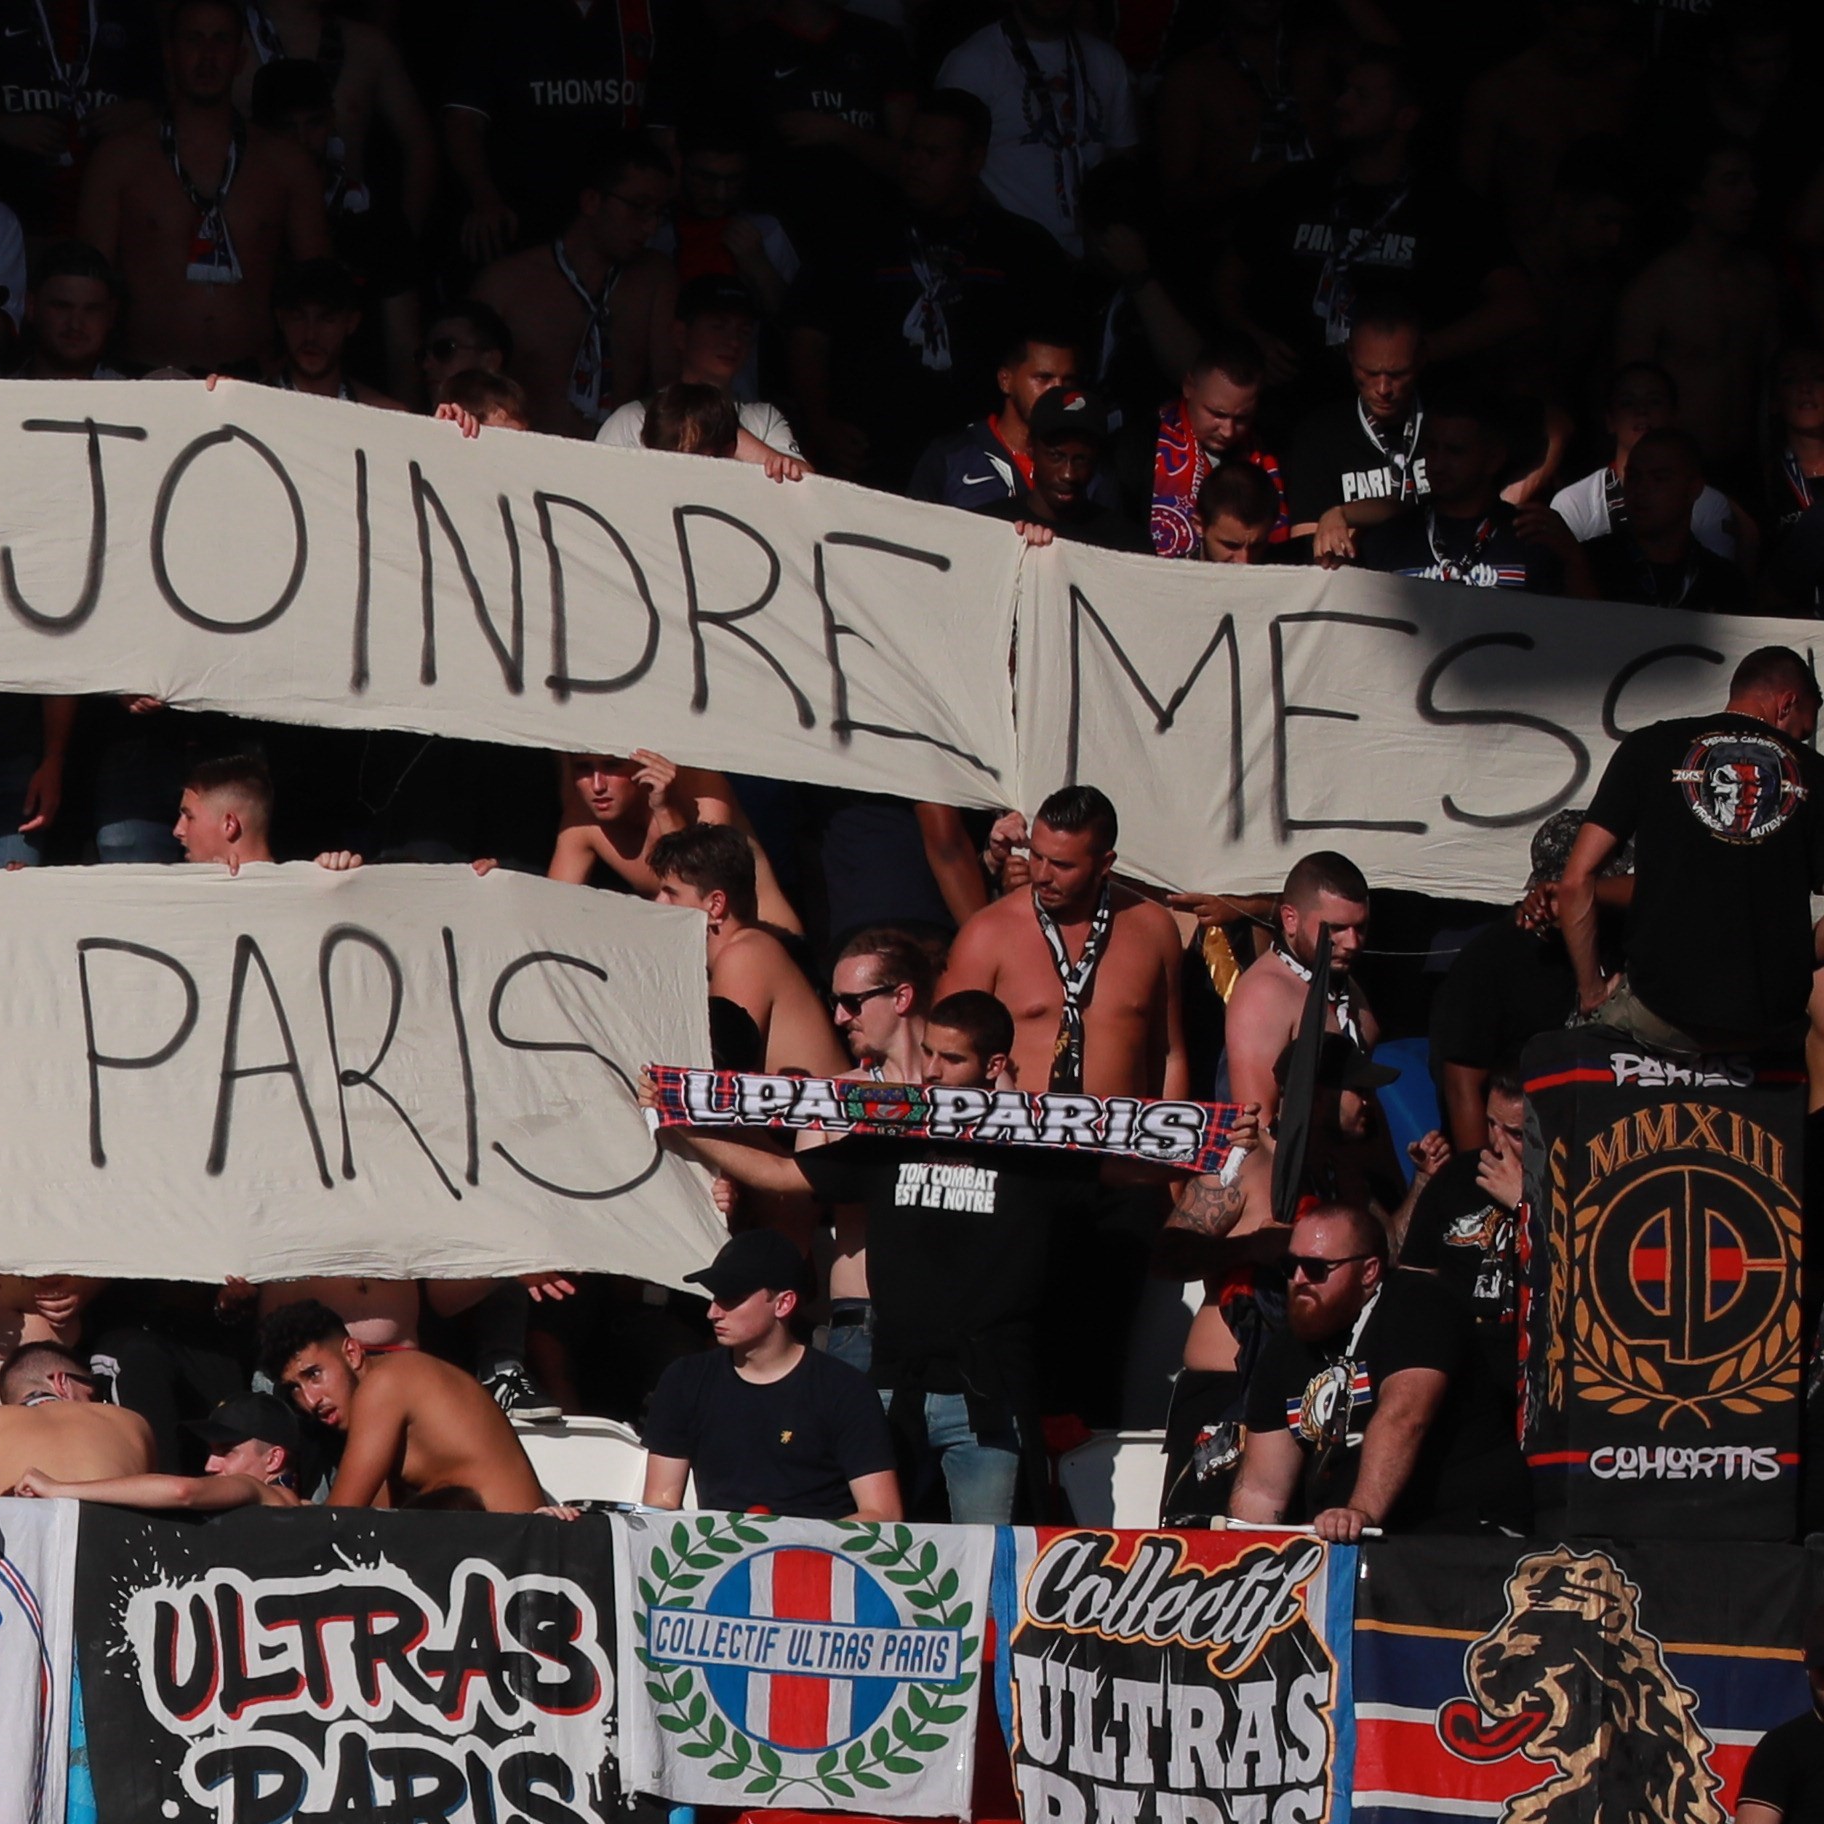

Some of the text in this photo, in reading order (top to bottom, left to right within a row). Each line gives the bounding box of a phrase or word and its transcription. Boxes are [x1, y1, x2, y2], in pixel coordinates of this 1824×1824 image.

[76, 921, 668, 1203] PARIS
[679, 1070, 1205, 1161] LPA PARIS
[1585, 1103, 1785, 1184] MMXIII
[894, 1182, 921, 1208] EST
[920, 1184, 944, 1209] LE
[930, 1164, 999, 1192] COMBAT
[147, 1567, 605, 1726] ULTRAS
[655, 1615, 950, 1674] COLLECTIF ULTRAS PARIS
[1026, 1537, 1324, 1675] Collectif
[1013, 1650, 1330, 1790] ULTRAS
